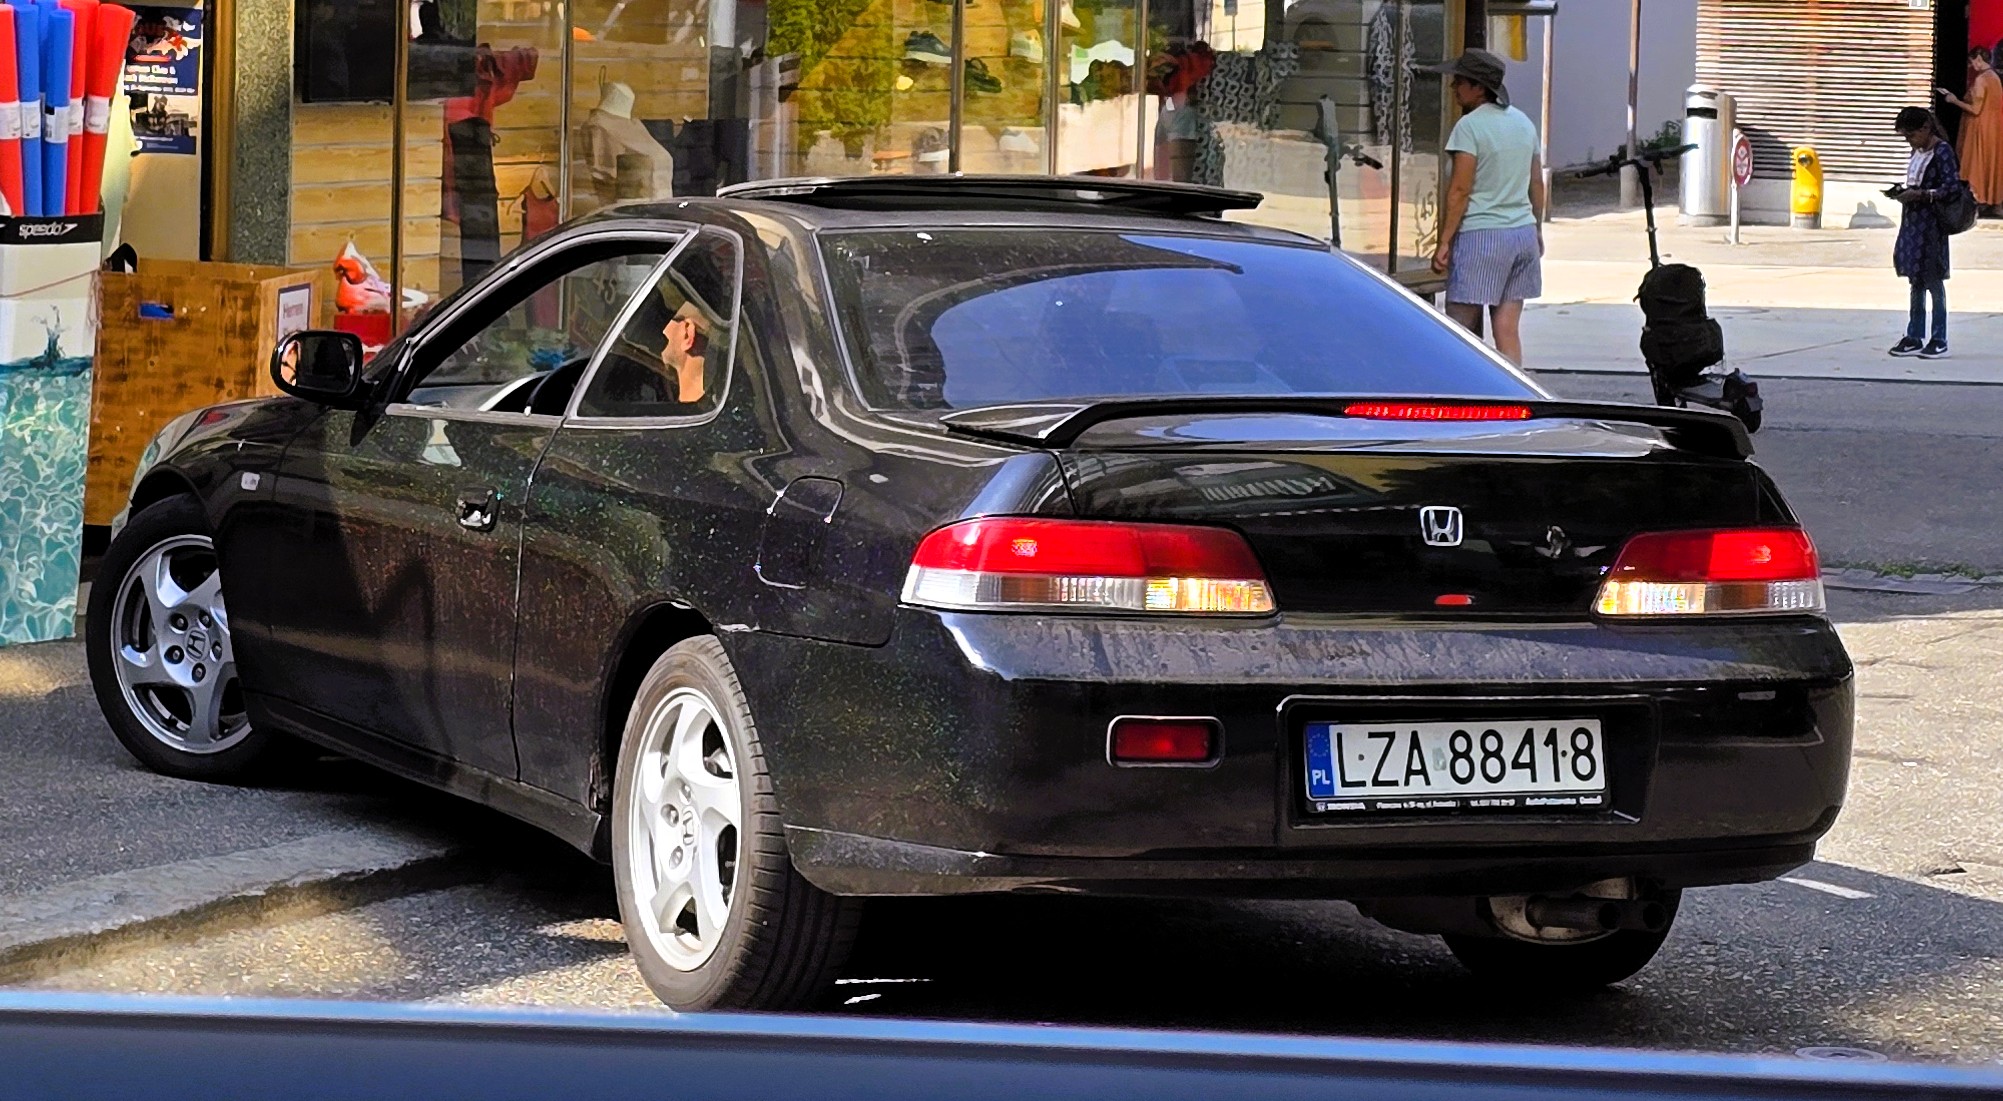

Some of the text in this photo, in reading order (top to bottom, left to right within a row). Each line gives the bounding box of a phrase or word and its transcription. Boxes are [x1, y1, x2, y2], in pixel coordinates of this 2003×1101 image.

[18, 220, 63, 240] speedo
[1336, 727, 1597, 788] LZA 88418
[1311, 769, 1331, 786] PL
